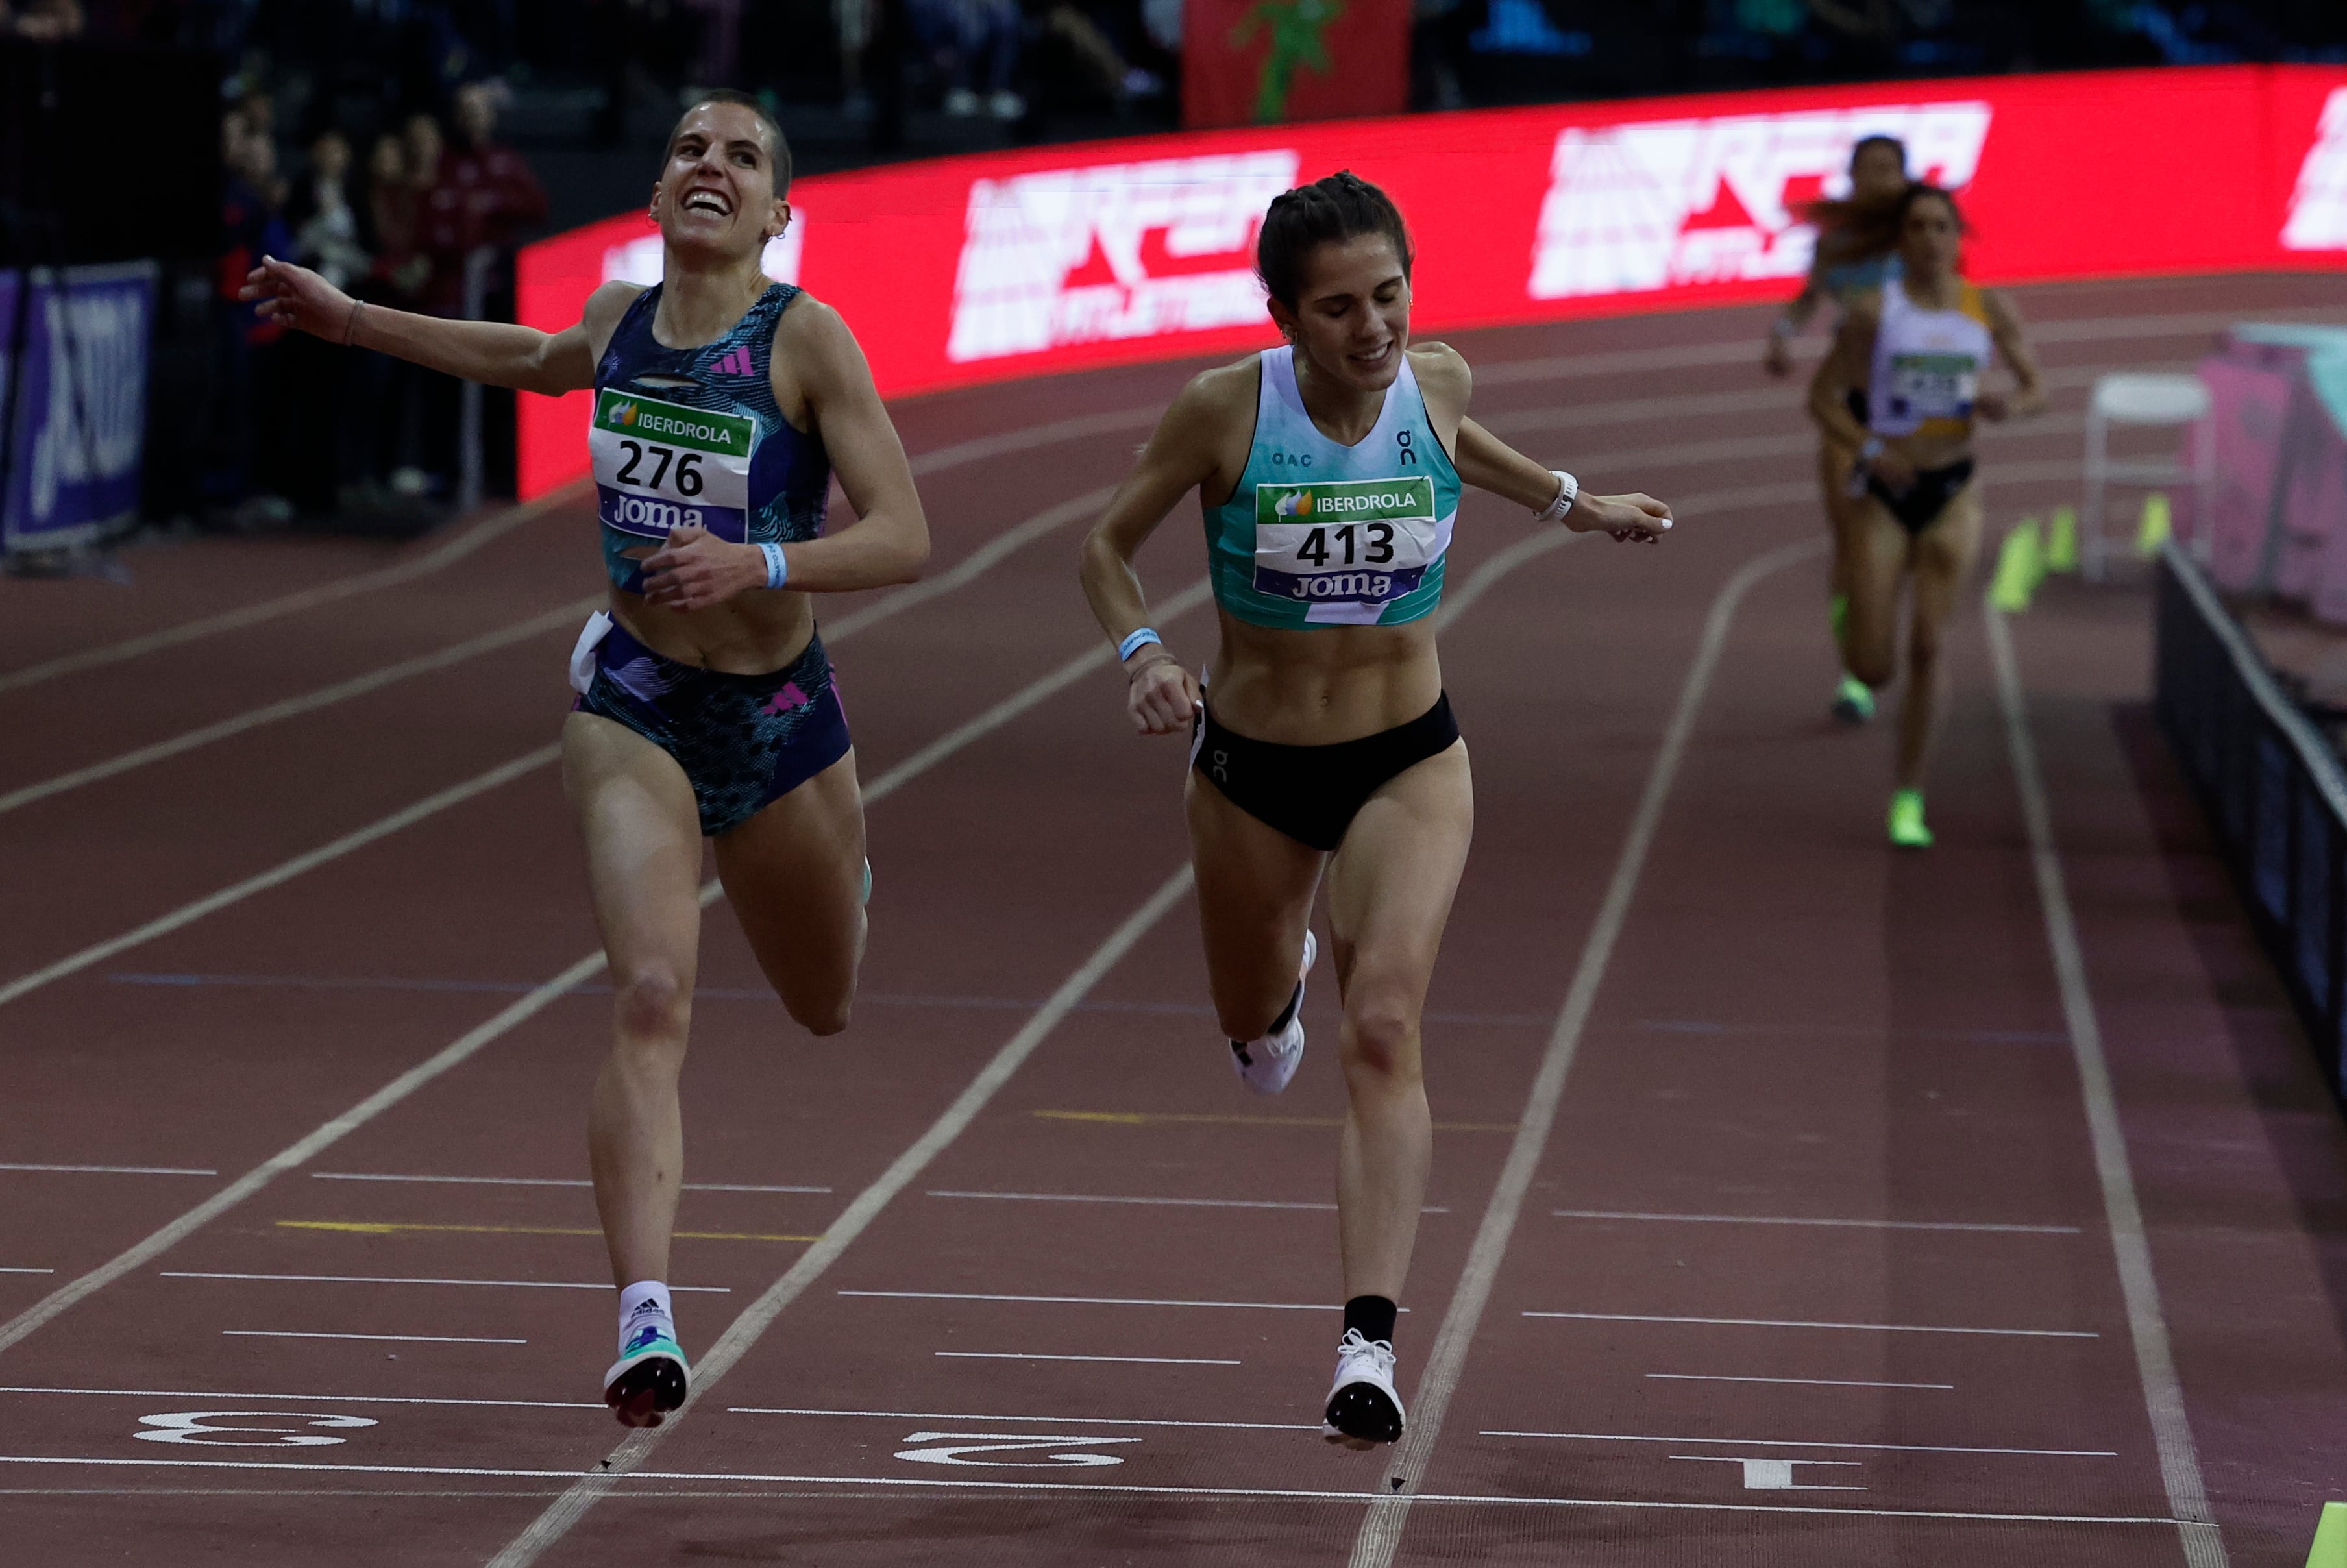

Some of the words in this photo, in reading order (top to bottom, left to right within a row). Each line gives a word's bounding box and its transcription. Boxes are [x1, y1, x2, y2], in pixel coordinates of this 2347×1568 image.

[637, 412, 731, 445] IBERDROLA
[617, 441, 703, 496] 276
[1272, 452, 1312, 467] OAC
[1316, 493, 1417, 513] IBERDROLA
[1297, 522, 1394, 567] 413
[1292, 572, 1392, 598] Joma
[132, 1411, 378, 1447] 3
[893, 1432, 1143, 1467] 2
